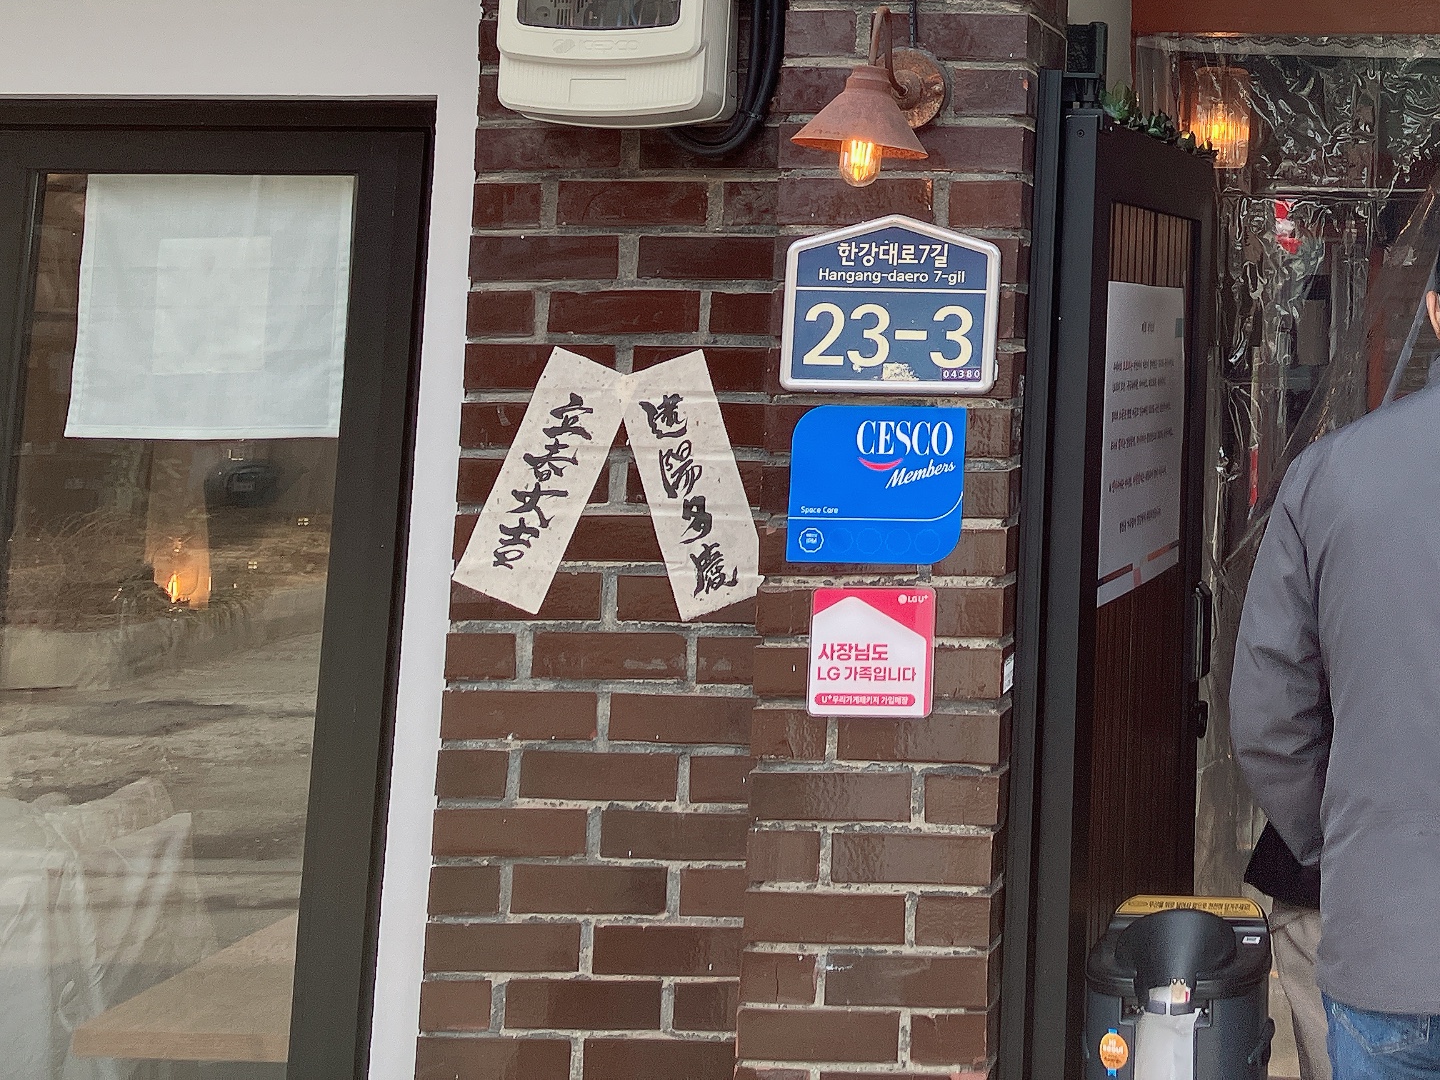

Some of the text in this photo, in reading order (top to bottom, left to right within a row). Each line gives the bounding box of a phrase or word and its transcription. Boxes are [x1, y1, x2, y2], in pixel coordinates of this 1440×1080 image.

[837, 241, 949, 267] 한강대로7길
[818, 267, 965, 286] Hangang-daero 7-gil
[802, 302, 973, 369] 23-3
[942, 369, 981, 380] 04380
[856, 420, 954, 456] CESCO
[885, 459, 956, 489] Members
[800, 505, 839, 515] Space Care
[817, 642, 889, 662] 사장님도
[816, 666, 917, 682] LG 가족입니다
